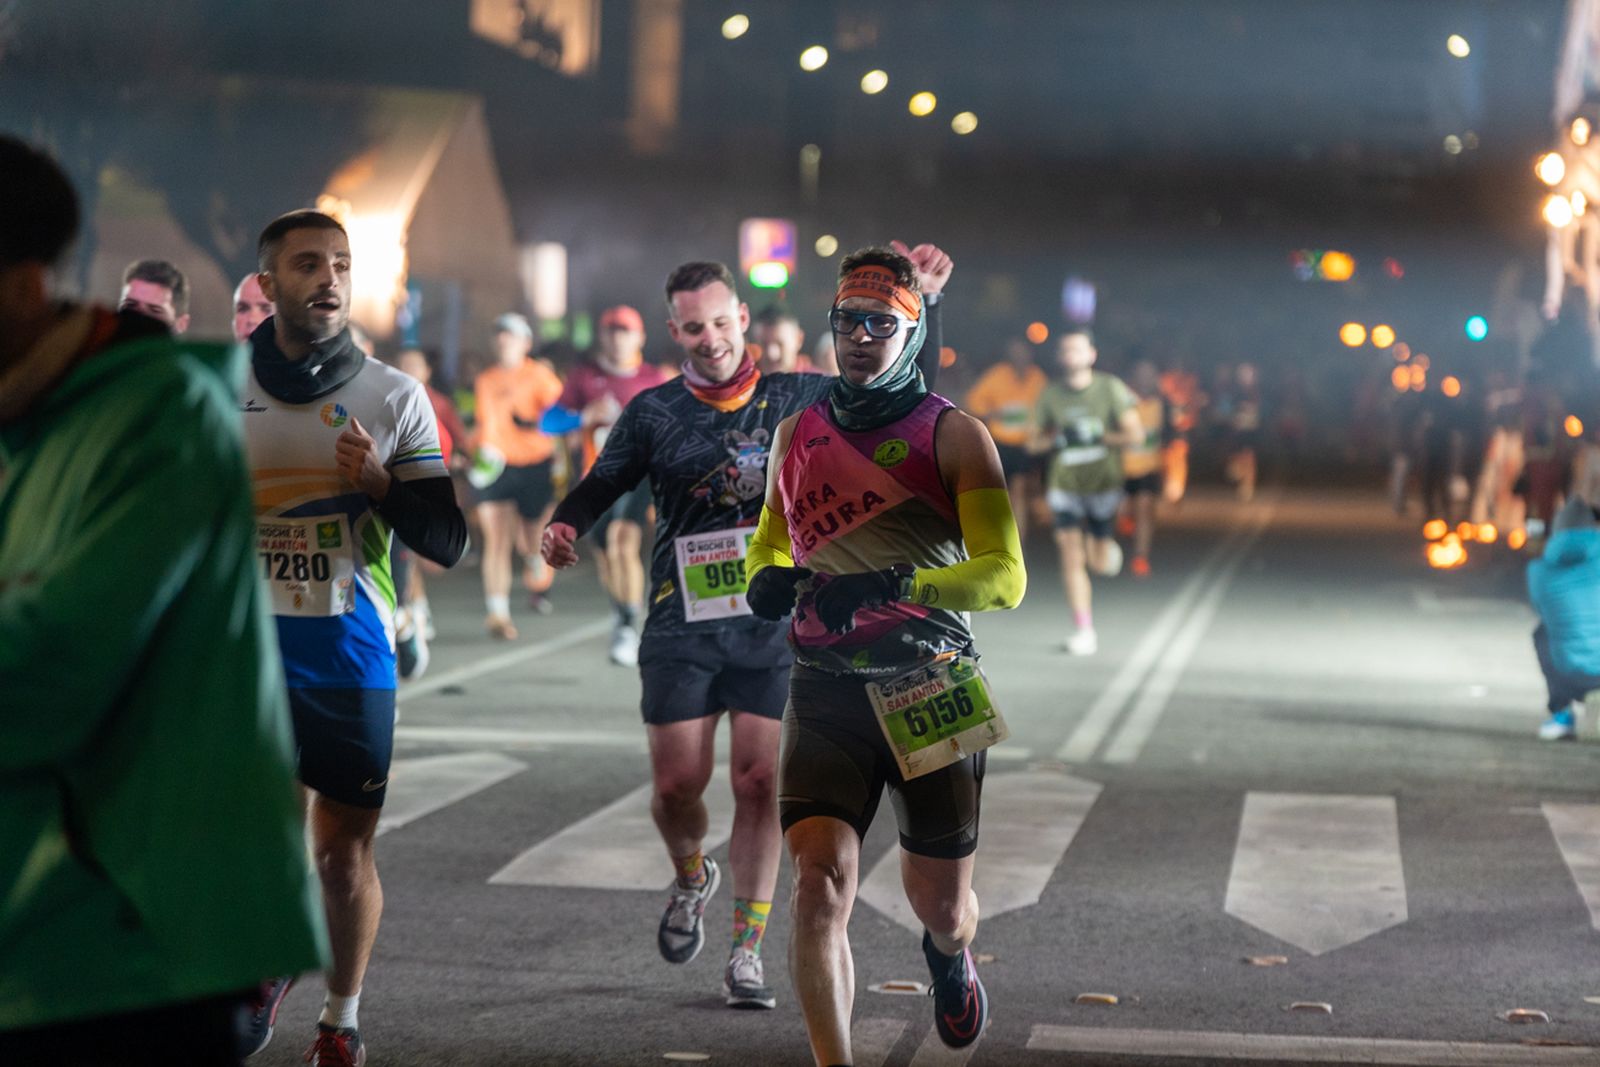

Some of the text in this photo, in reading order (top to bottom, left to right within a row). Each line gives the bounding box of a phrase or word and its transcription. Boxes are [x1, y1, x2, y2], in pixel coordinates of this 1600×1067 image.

[688, 556, 706, 565] SAN
[886, 694, 908, 712] SAN
[903, 686, 974, 738] 6156
